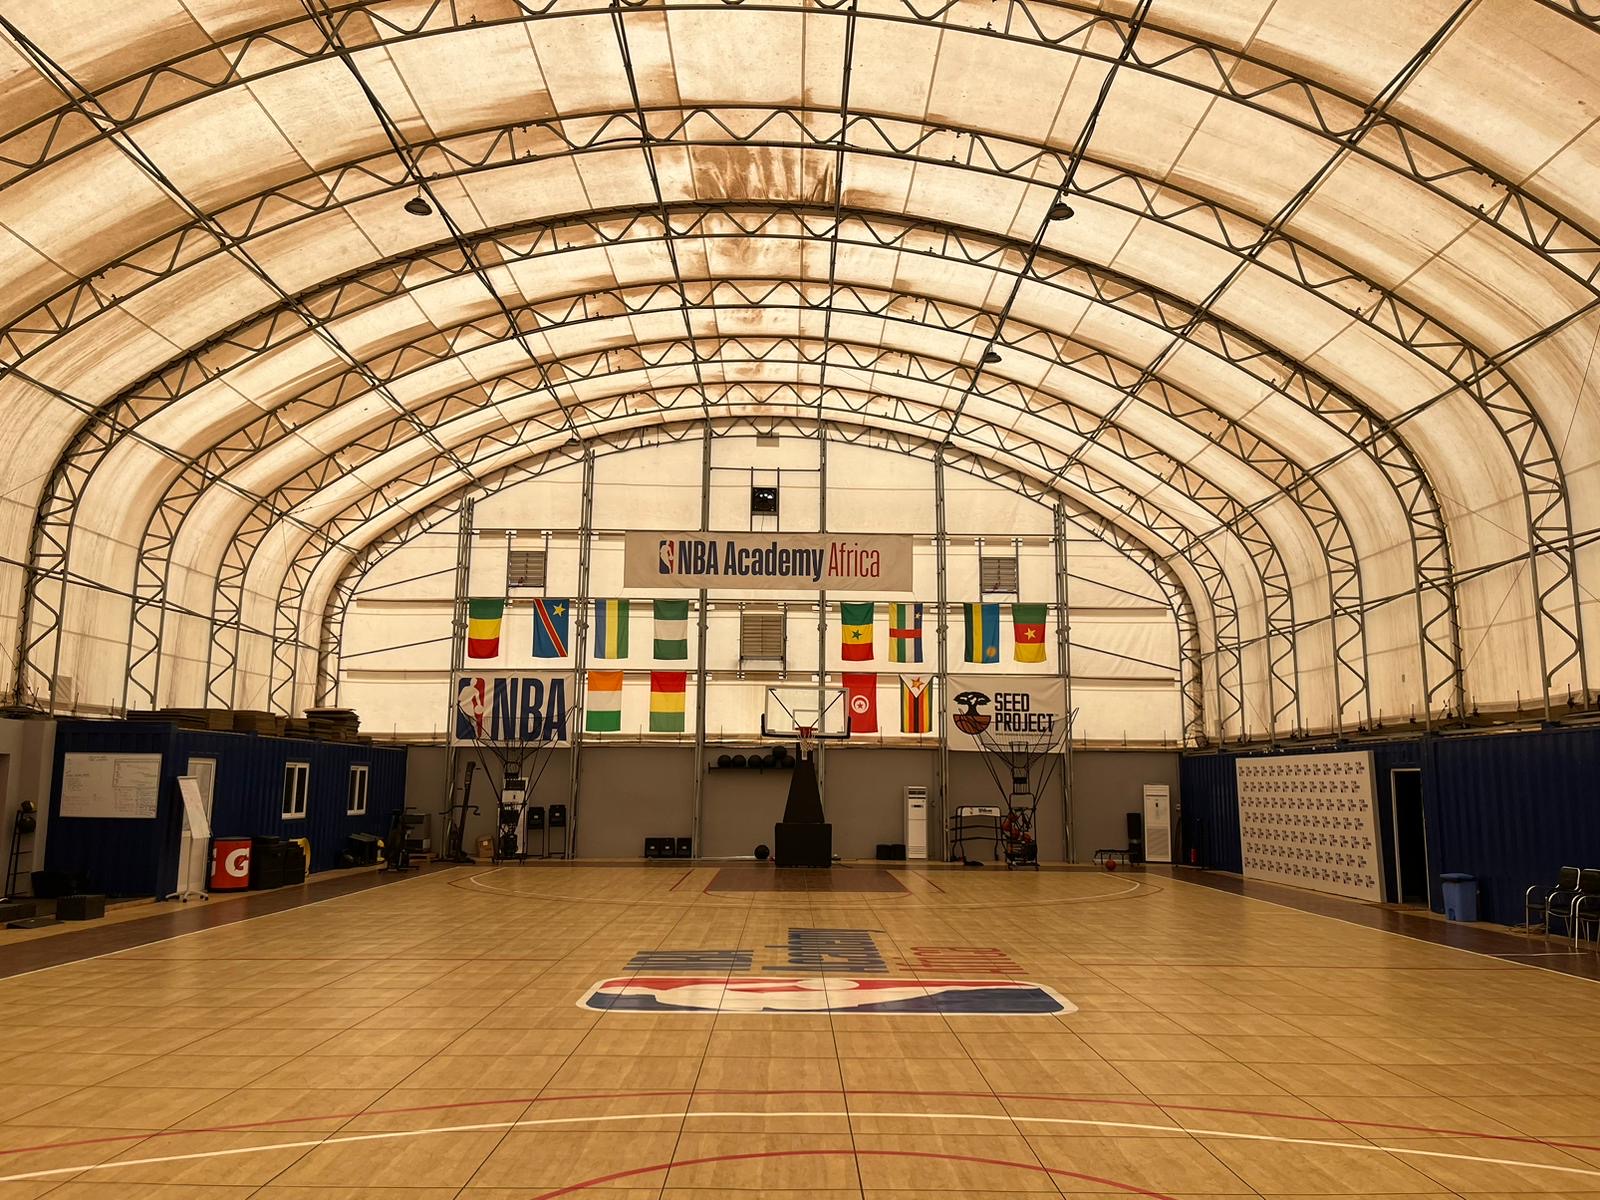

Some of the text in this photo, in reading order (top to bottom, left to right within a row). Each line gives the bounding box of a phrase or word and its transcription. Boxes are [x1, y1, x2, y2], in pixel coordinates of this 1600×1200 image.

[677, 540, 881, 582] NBA Academy Africa
[490, 677, 567, 741] NBA
[994, 692, 1030, 713] SEED
[994, 712, 1055, 733] PROJECT
[224, 847, 251, 878] G
[622, 950, 755, 971] NBA
[761, 927, 889, 974] Academy
[892, 946, 1030, 975] Africa
